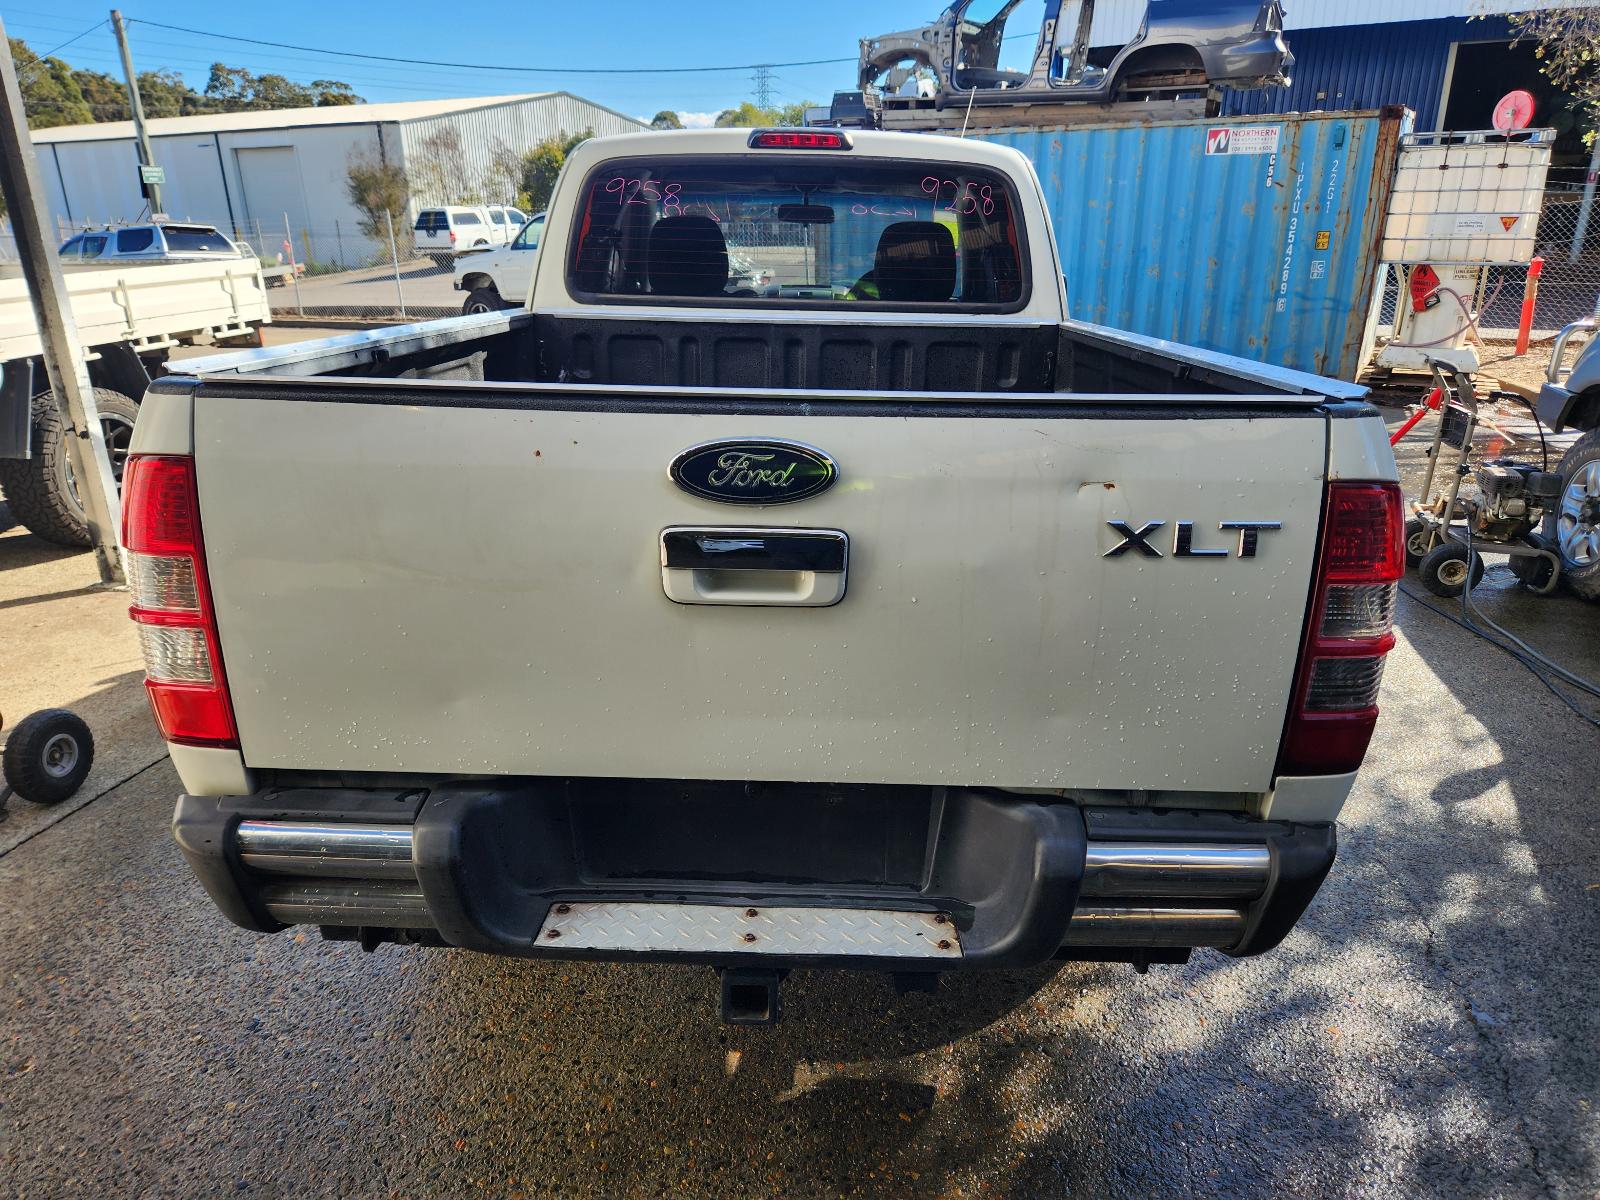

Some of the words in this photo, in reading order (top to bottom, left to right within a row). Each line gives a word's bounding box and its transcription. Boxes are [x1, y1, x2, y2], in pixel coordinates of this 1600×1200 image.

[1231, 128, 1277, 137] NORTHERN
[1265, 154, 1276, 188] C56
[1326, 159, 1339, 214] 22G1
[605, 177, 682, 206] 9258
[921, 176, 995, 216] 9258
[707, 451, 798, 488] Ford
[1102, 519, 1282, 557] XLT
